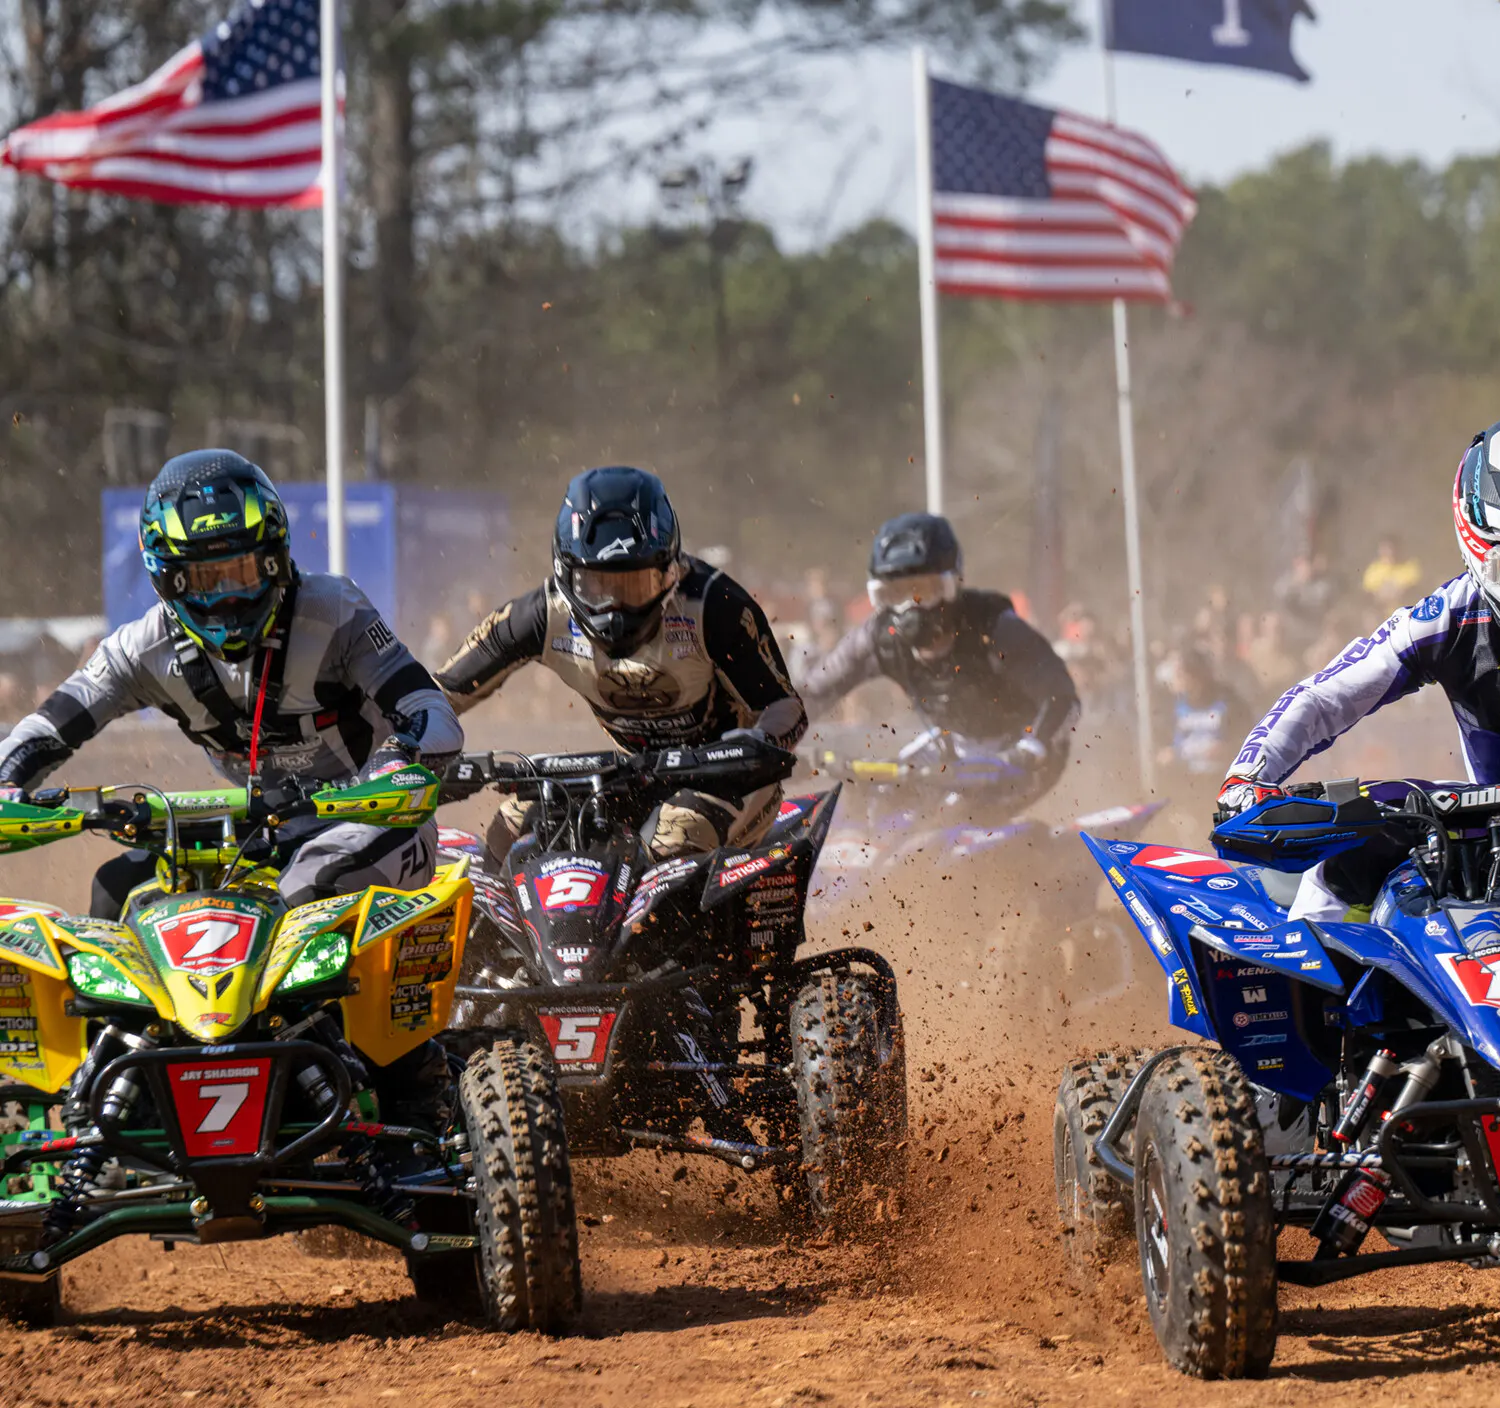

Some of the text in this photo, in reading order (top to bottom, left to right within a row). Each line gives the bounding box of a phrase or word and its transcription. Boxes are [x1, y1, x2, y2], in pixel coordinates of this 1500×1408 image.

[191, 512, 238, 532] FLY
[665, 751, 682, 768] 5
[706, 747, 744, 762] WILKIN
[457, 763, 474, 781] 5
[409, 788, 426, 809] 7
[617, 863, 632, 893] KENDA
[545, 871, 597, 908] 5
[177, 898, 235, 914] MAXXIS
[182, 920, 240, 960] 7
[0, 1018, 37, 1031] CTION
[554, 1016, 601, 1061] 5
[180, 1067, 259, 1082] JAY SHADRON
[196, 1083, 249, 1134] 7
[1328, 1202, 1369, 1234] Elka
